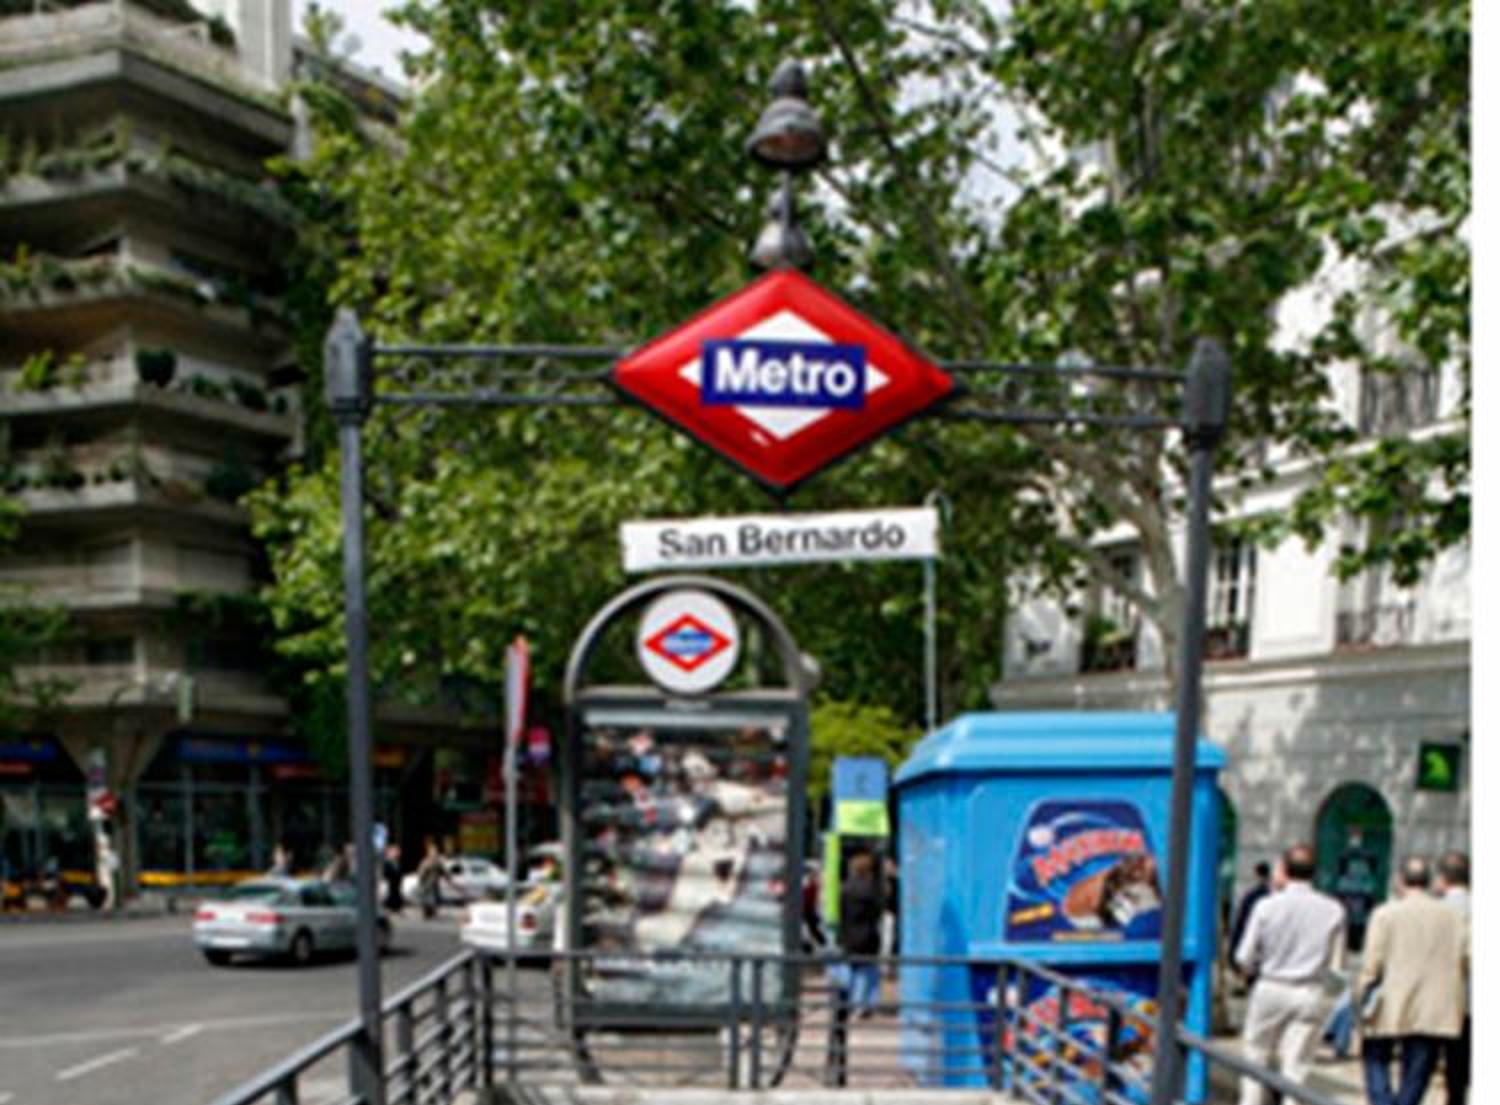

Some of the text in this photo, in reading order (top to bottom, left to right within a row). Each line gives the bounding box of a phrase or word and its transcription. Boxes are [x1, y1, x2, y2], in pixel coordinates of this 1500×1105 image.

[715, 349, 855, 395] Metro
[658, 519, 906, 558] San Bernardo
